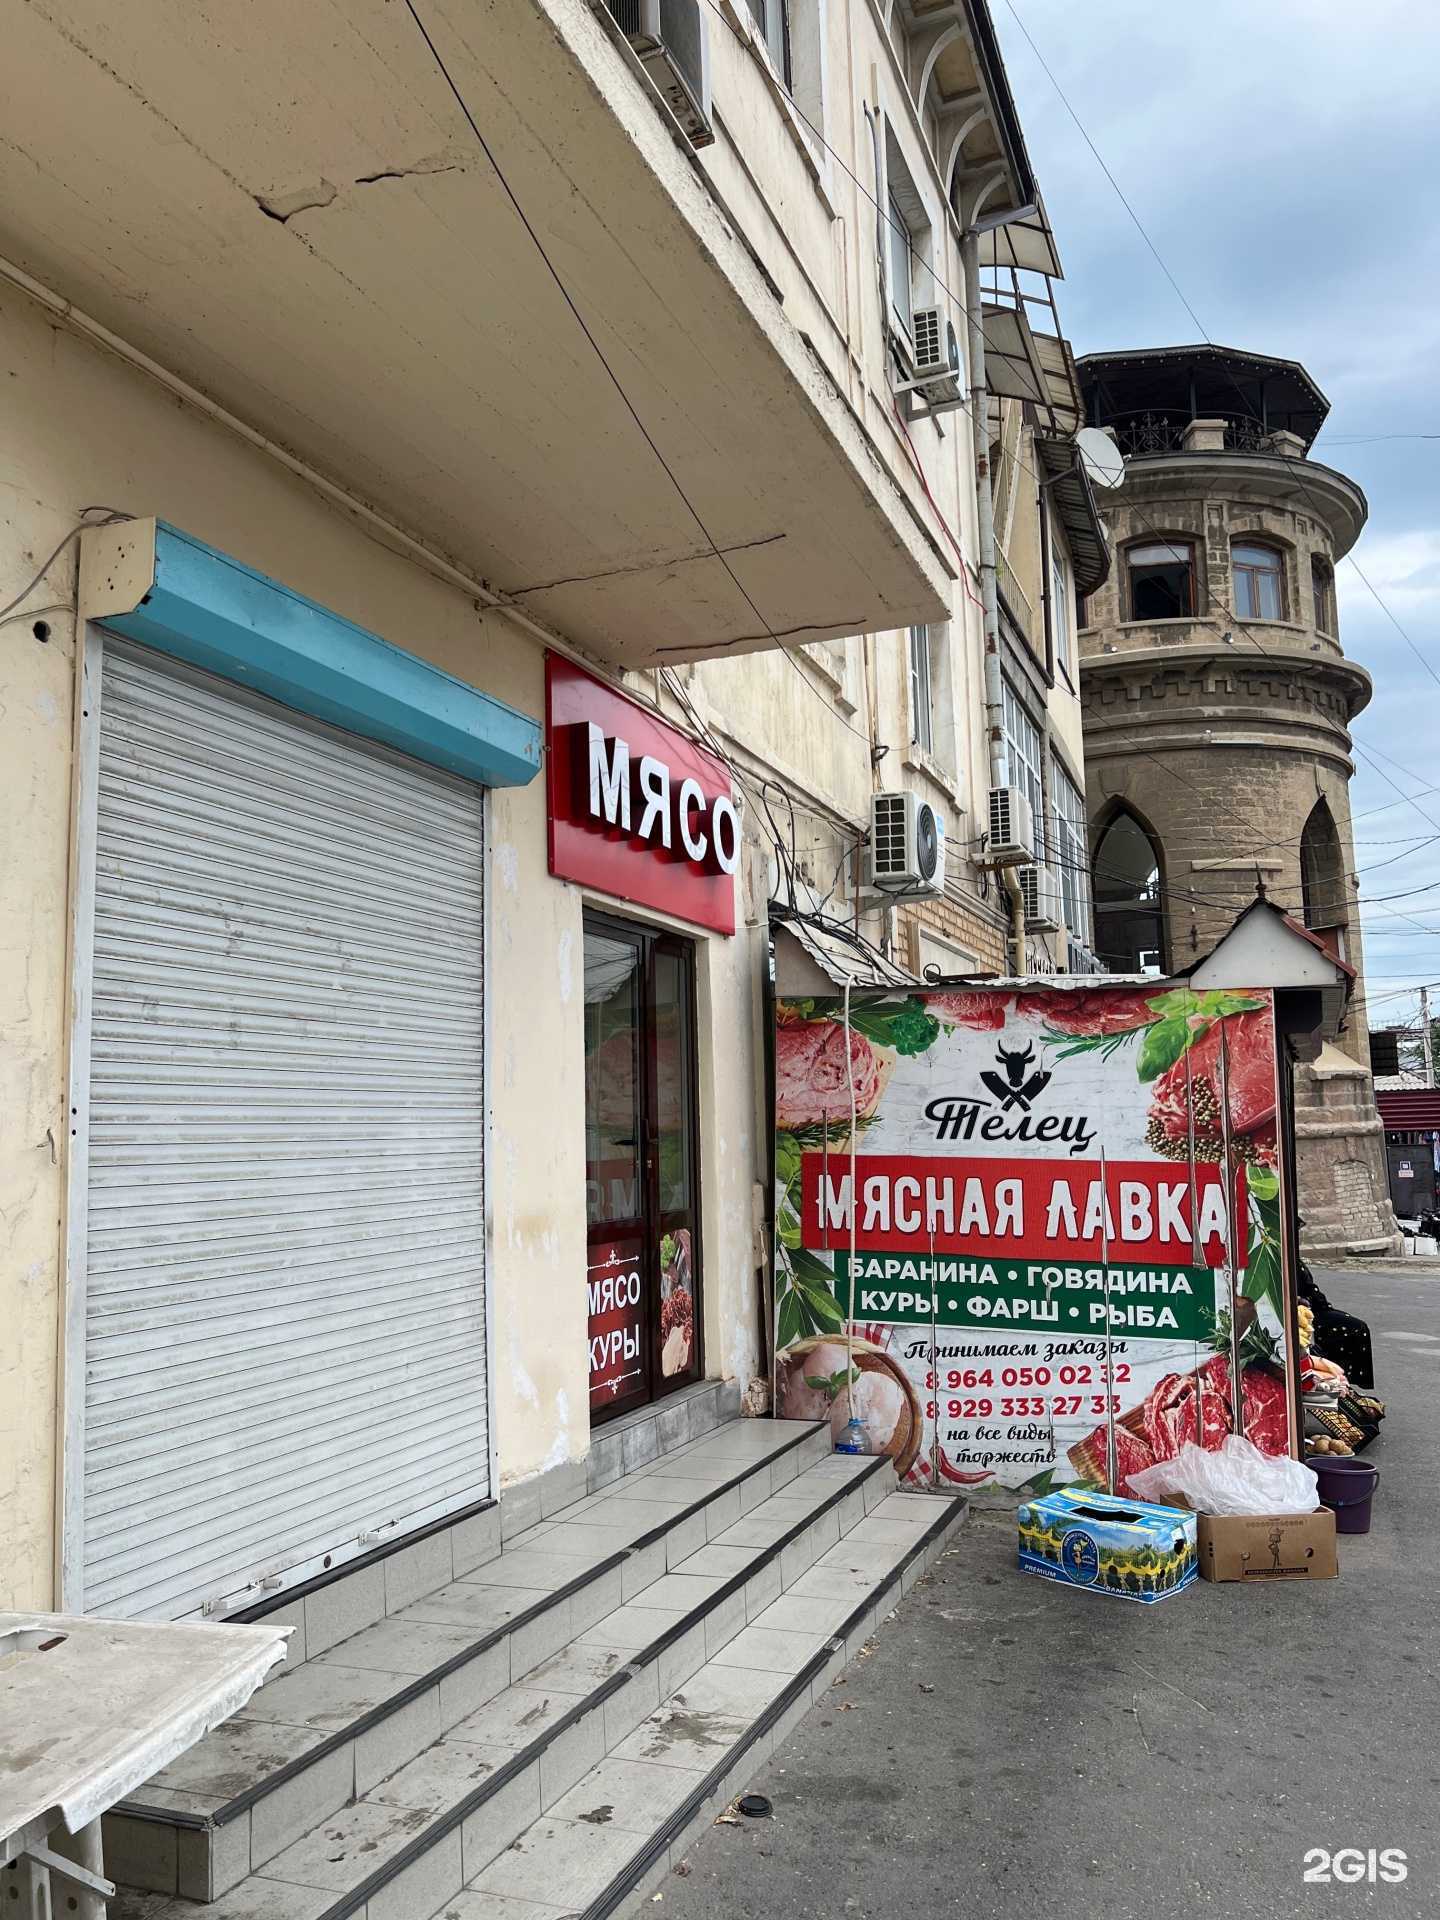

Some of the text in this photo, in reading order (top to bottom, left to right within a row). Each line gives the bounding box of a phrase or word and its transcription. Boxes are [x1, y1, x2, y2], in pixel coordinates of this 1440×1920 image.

[588, 720, 741, 875] МЯСО
[924, 1096, 1098, 1156] Телец
[816, 1174, 1229, 1245] МЯСНАЯ ЛАВКА
[587, 1271, 641, 1316] МЯСО
[847, 1257, 1193, 1295] БАРАНИНА ГОВЯДИНА
[861, 1290, 1179, 1329] КУРЫ ФАРШ РЫБА
[588, 1324, 640, 1373] КУРЫ
[904, 1339, 1128, 1365] Принимаем заказы
[925, 1363, 1131, 1390] 8 964 050 02 32
[926, 1394, 1121, 1419] 8 929 333 27 33
[946, 1422, 1053, 1441] на все виды
[956, 1448, 1057, 1468] торжеств
[1024, 1563, 1057, 1578] PREMIUM
